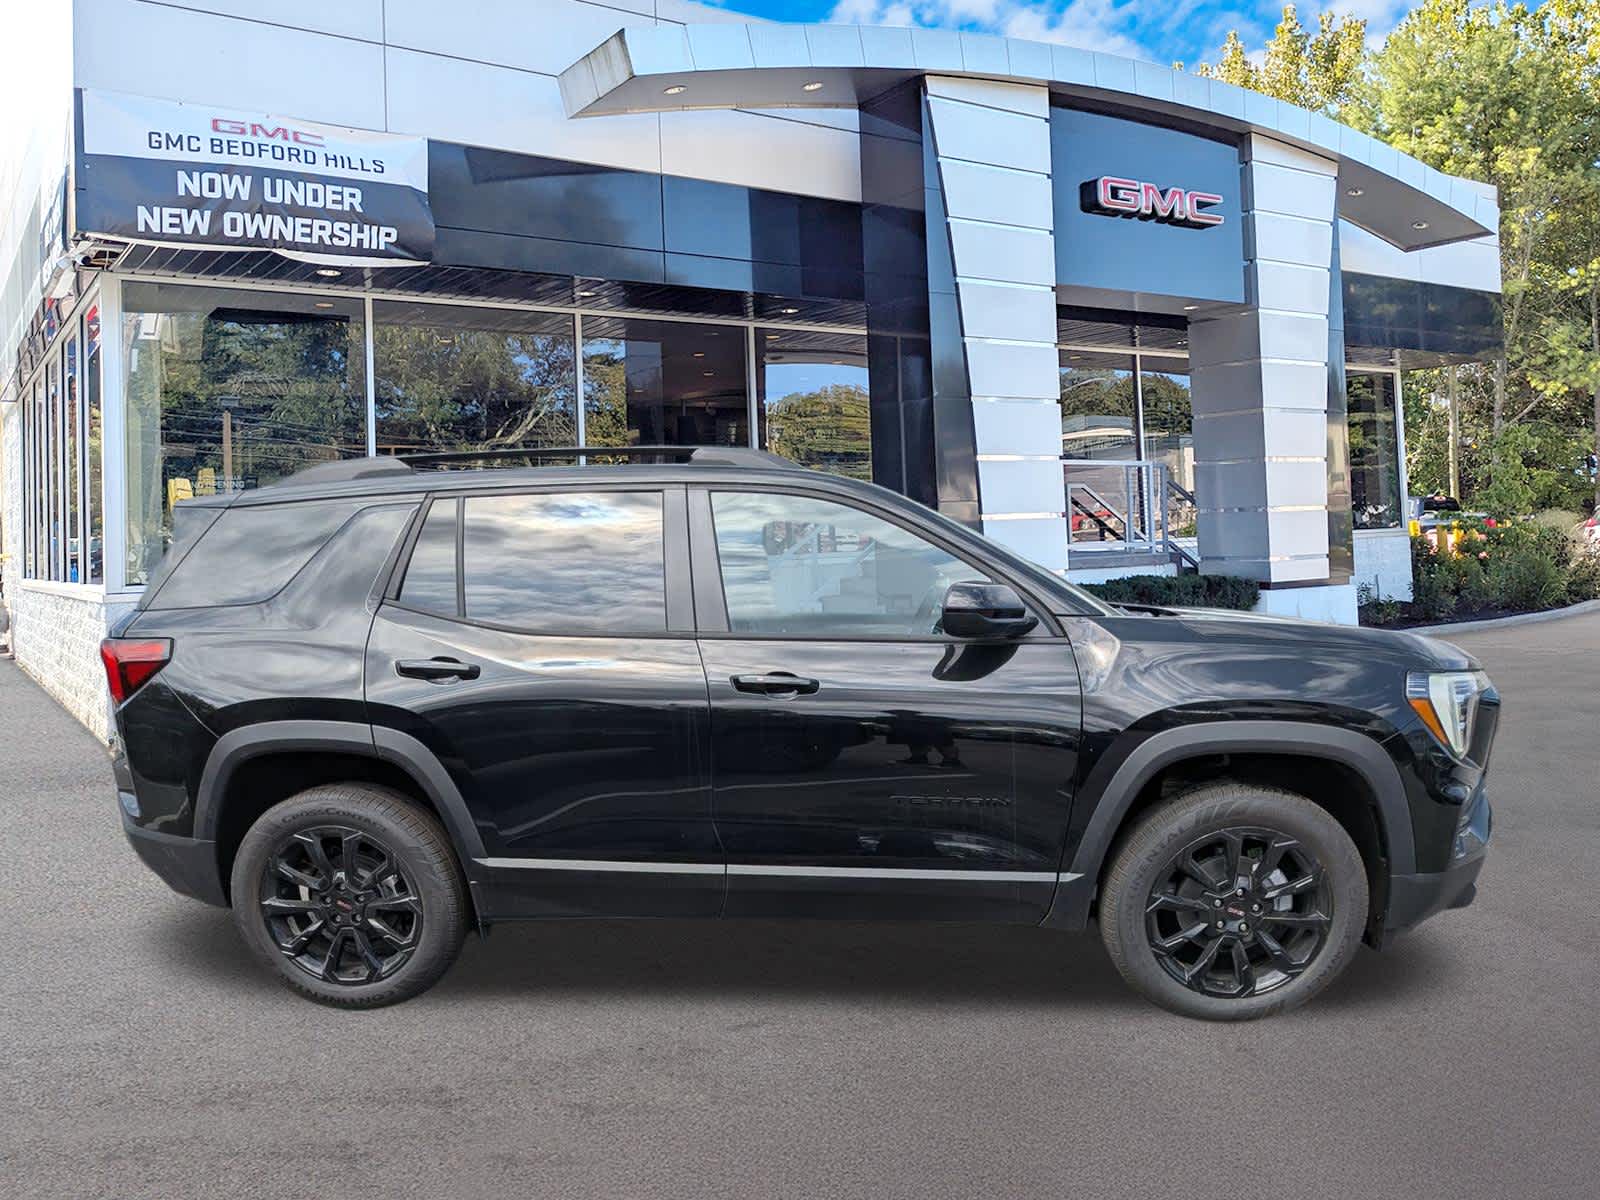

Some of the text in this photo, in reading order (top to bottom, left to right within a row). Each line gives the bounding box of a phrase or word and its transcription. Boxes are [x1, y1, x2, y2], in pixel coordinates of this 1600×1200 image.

[148, 131, 386, 174] GMC BEDFORD HILLS
[210, 117, 327, 148] GMC
[176, 170, 363, 213] NOW UNDER
[1096, 175, 1225, 225] GMC
[136, 204, 398, 251] NEW OWNERSHIP
